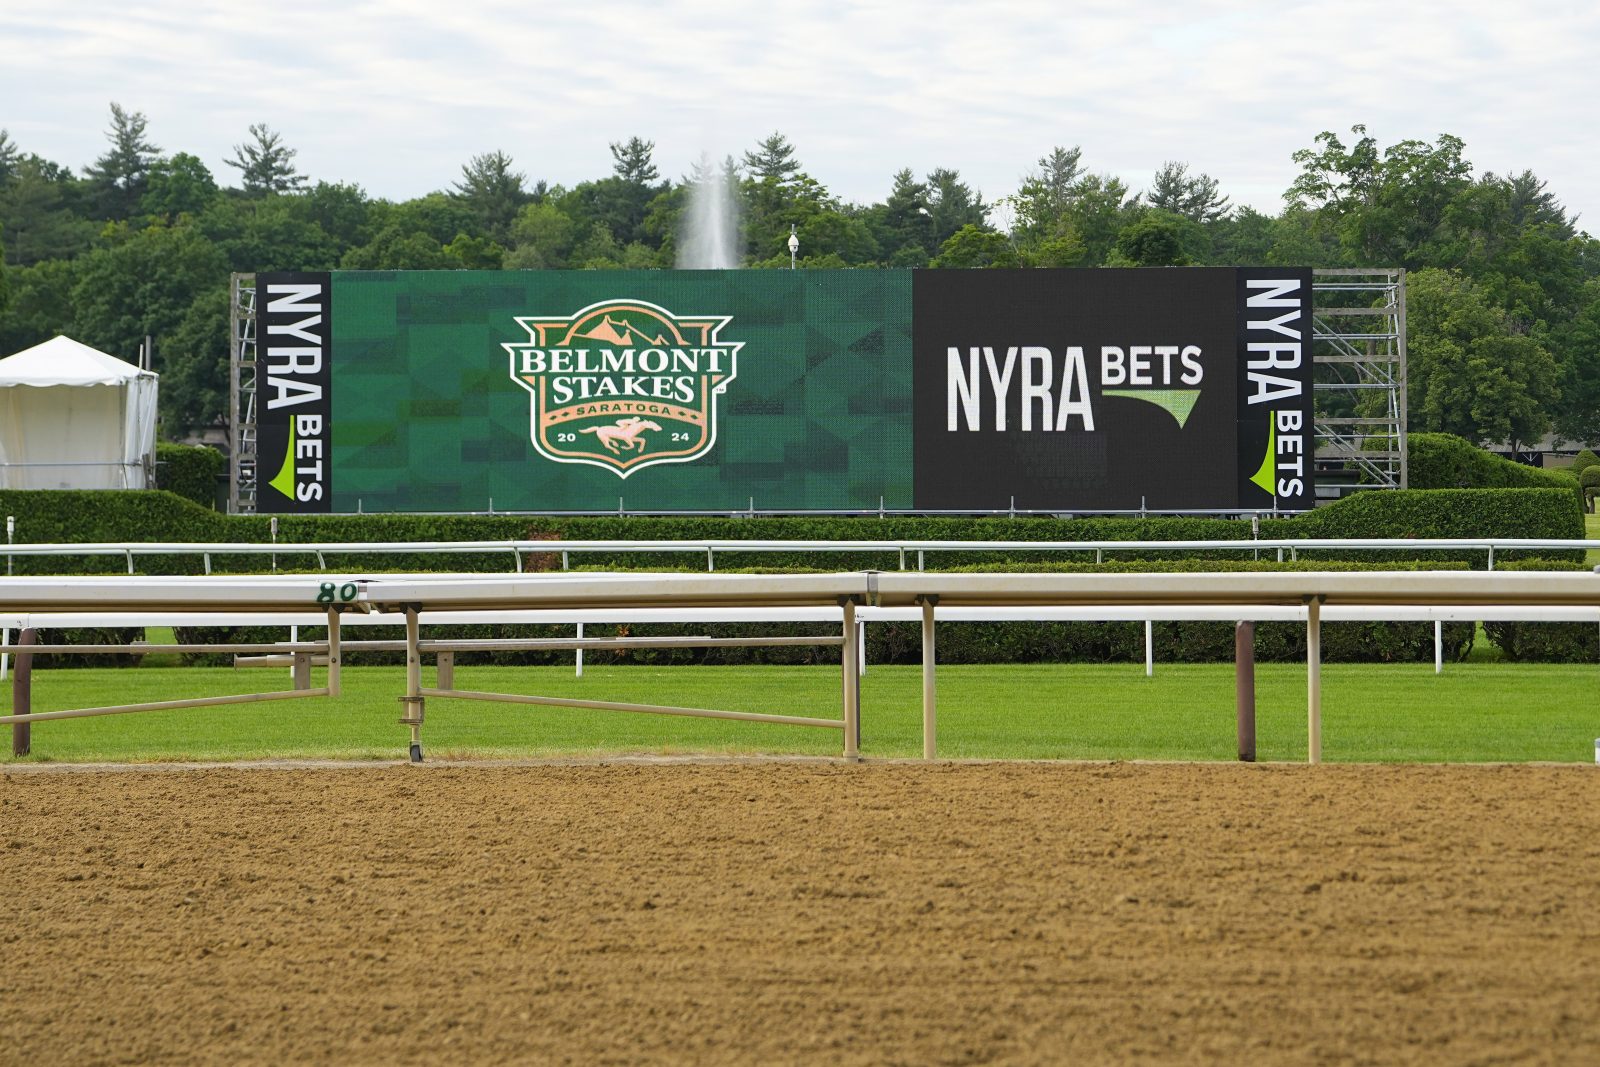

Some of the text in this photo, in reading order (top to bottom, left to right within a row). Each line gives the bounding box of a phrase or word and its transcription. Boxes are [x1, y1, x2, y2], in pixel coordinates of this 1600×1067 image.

[520, 349, 728, 373] BELMONT
[267, 284, 323, 502] NYRA BETS
[552, 376, 694, 404] STAKES
[947, 345, 1203, 432] NYRA BETS
[1246, 279, 1304, 498] NYRA BETS
[576, 403, 671, 416] SARATOGA
[558, 433, 690, 442] 20 24
[317, 582, 357, 602] 80
